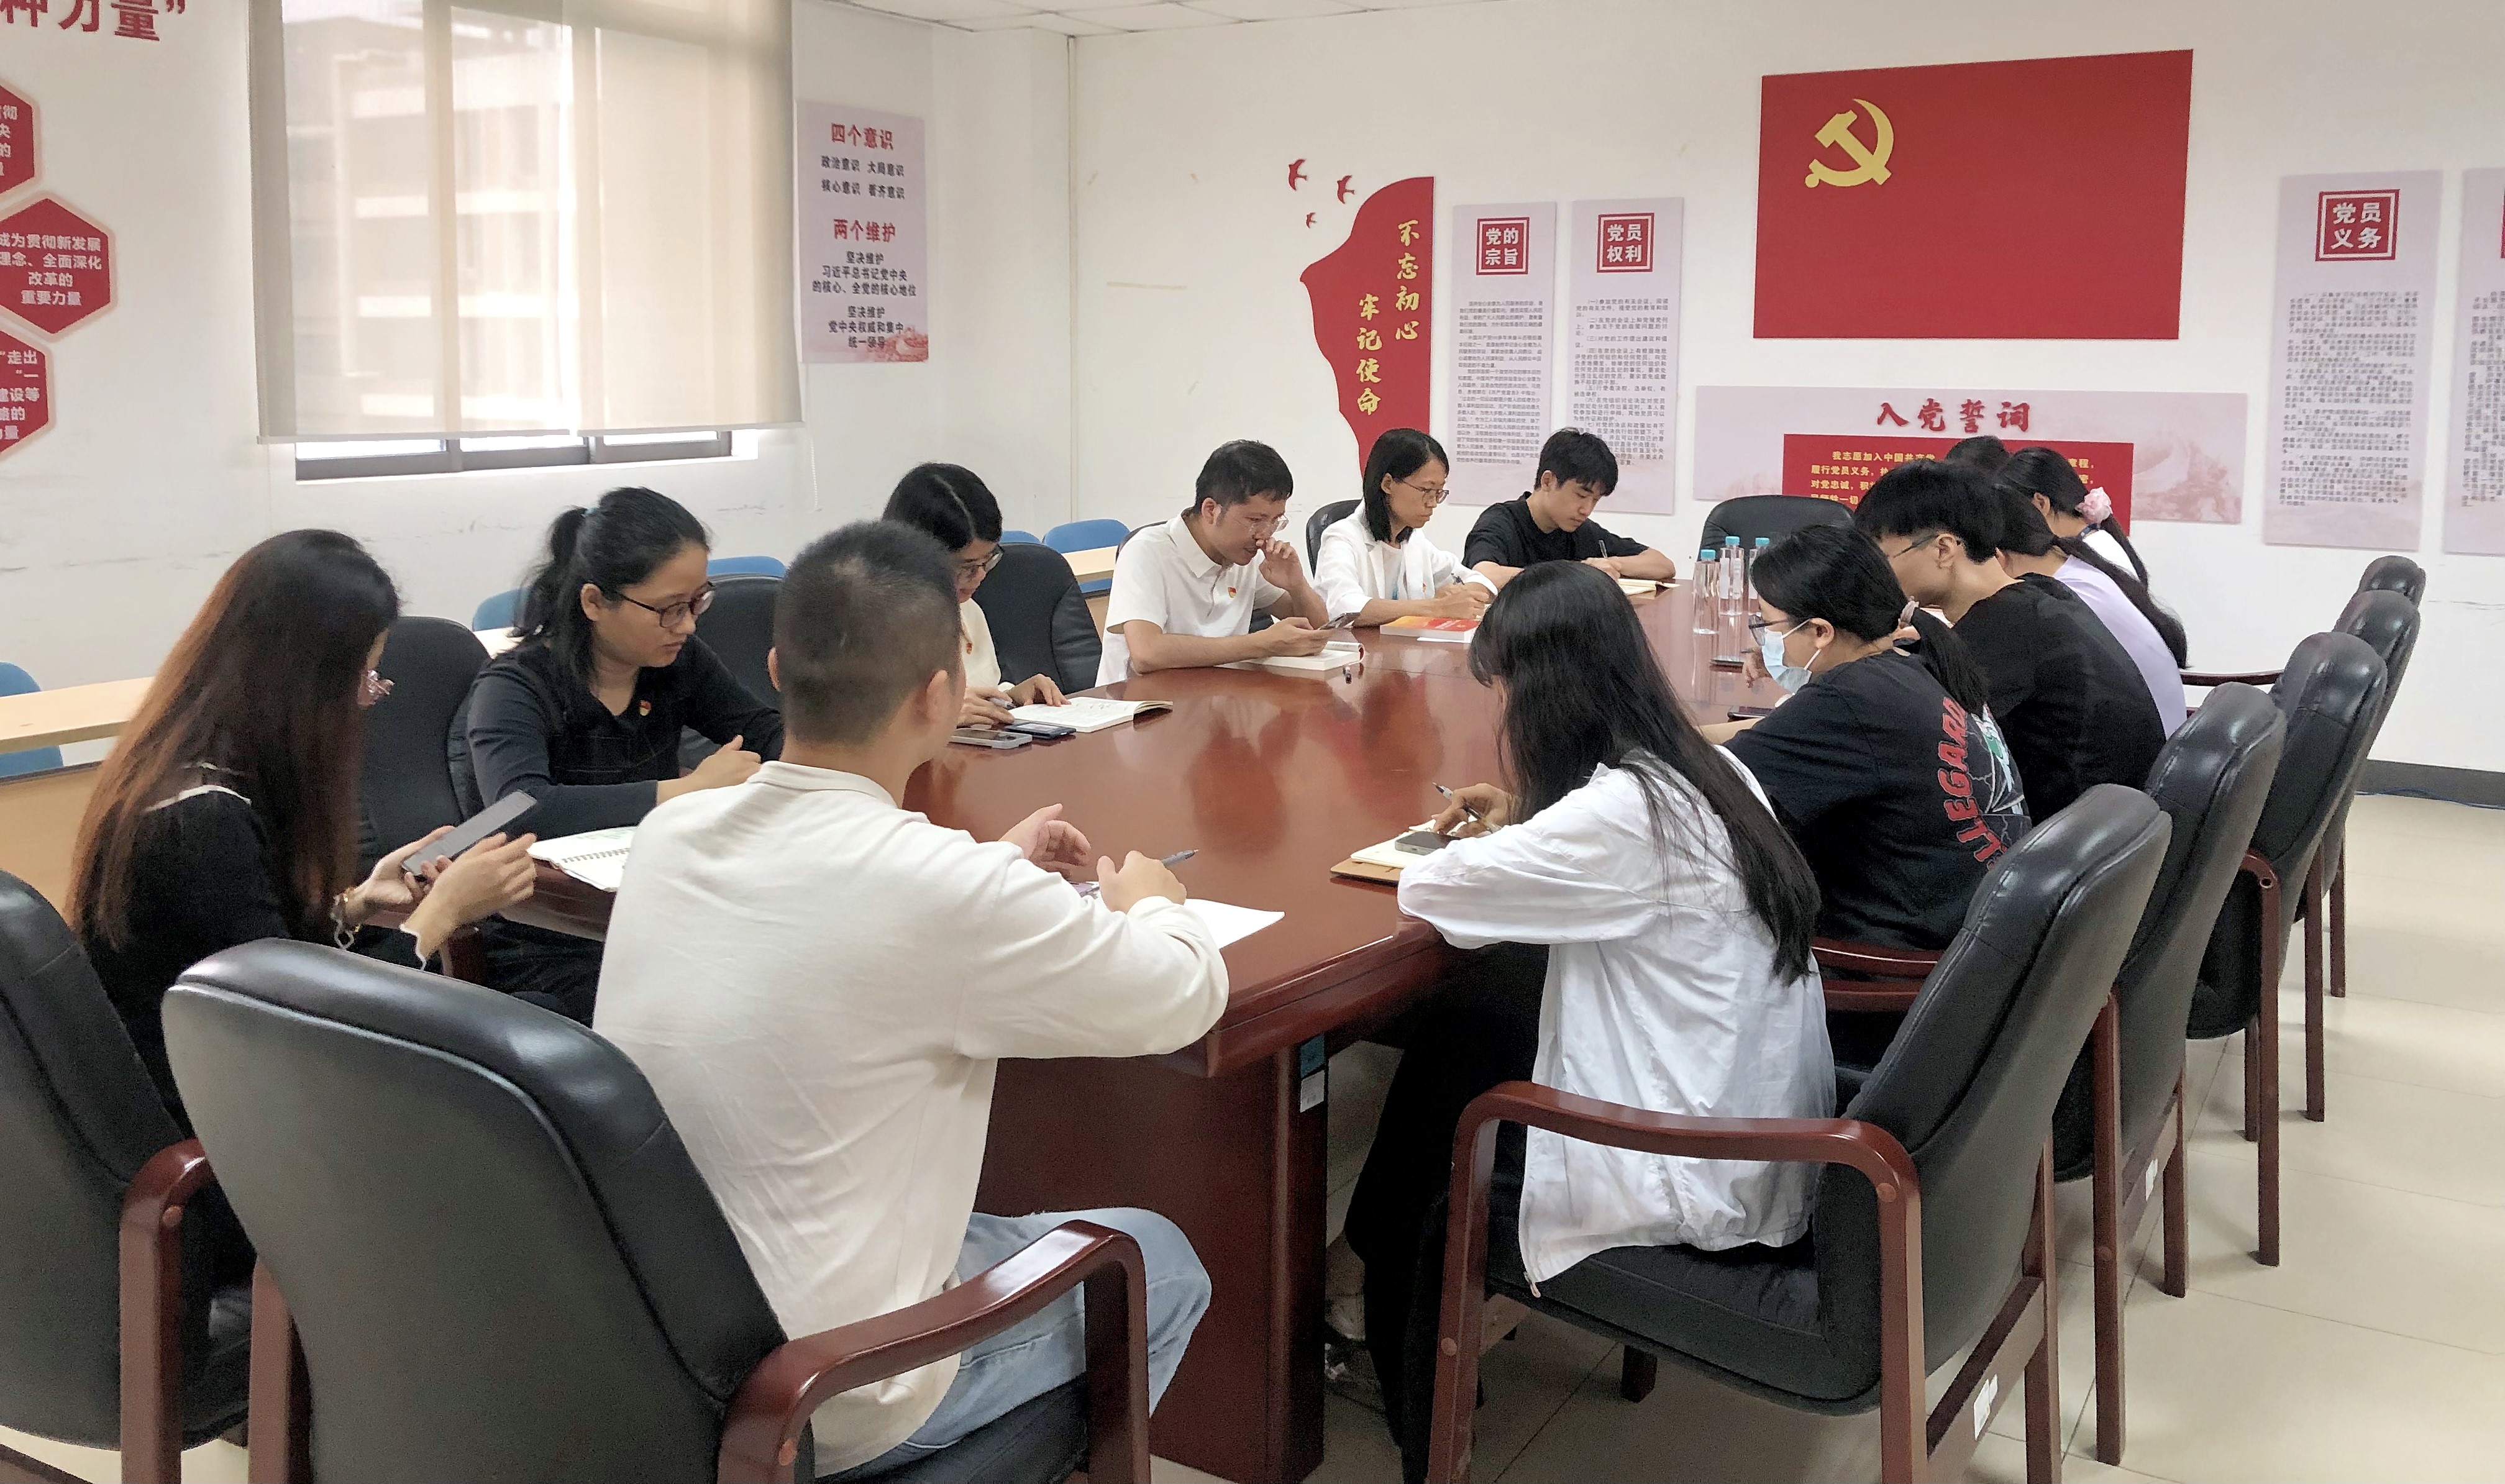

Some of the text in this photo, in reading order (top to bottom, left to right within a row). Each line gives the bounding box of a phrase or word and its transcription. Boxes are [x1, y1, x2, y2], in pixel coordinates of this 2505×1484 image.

[0, 104, 17, 120] 彻
[831, 123, 894, 150] 四个意识
[2332, 202, 2382, 224] 党员
[833, 218, 896, 244] 两个维护
[1485, 227, 1520, 245] 党的
[1607, 224, 1643, 242] 党员
[2330, 227, 2383, 250] 义务
[1485, 248, 1519, 266] 宗旨
[1607, 244, 1643, 263] 权利
[28, 271, 74, 288] 改革的
[1395, 219, 1420, 340] 不忘初心
[21, 289, 82, 306] 重要力量
[1356, 293, 1382, 416] 牢记使命
[1876, 398, 2030, 434] 入党誓词
